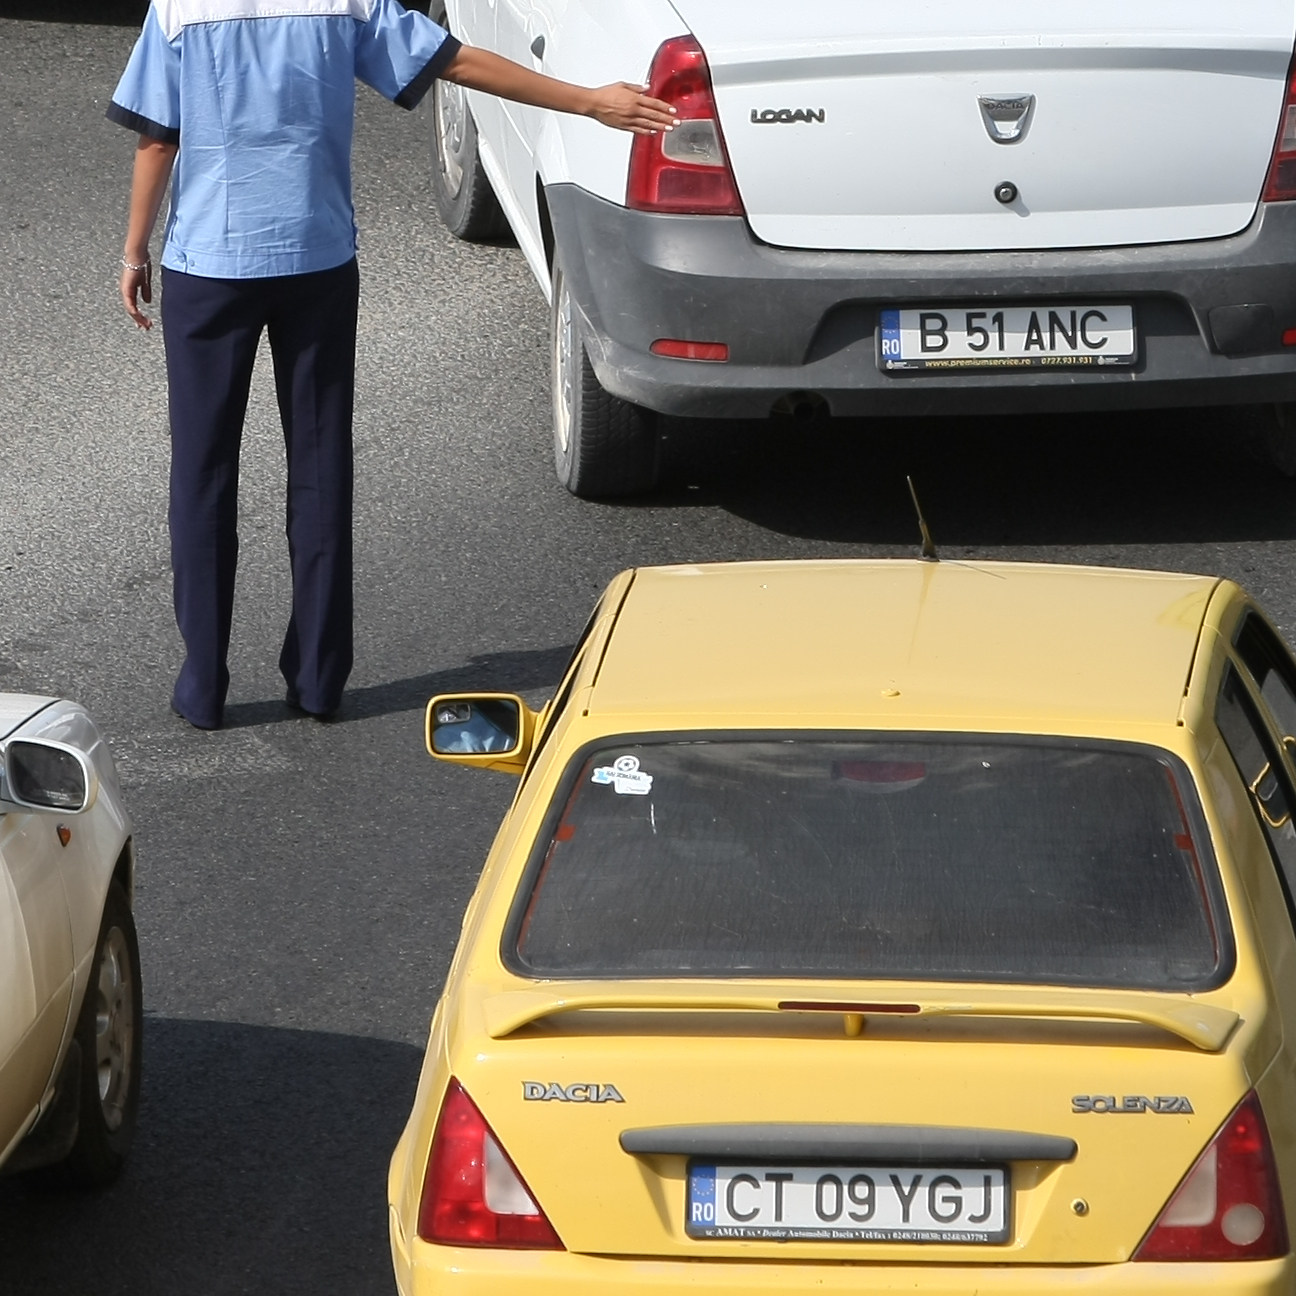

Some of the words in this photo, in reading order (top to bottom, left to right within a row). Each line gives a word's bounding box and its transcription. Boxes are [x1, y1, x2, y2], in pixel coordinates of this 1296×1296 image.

[987, 100, 1025, 110] DACIA
[750, 108, 826, 124] LOGAN
[919, 312, 949, 353] B
[965, 311, 1005, 352] 51
[1023, 310, 1108, 352] ANC
[882, 338, 900, 356] RO
[925, 357, 1031, 368] www.premiumservice.ro
[1041, 356, 1093, 365] 0727.931.931
[522, 1081, 627, 1103] DACIA
[1071, 1095, 1195, 1114] SOLENZA
[725, 1172, 794, 1223] CT
[815, 1173, 876, 1223] 09
[889, 1174, 993, 1224] YGJ
[692, 1202, 714, 1222] RO
[716, 1227, 745, 1236] AMAT
[789, 1229, 831, 1238] Automobile
[832, 1229, 854, 1238] Dacia
